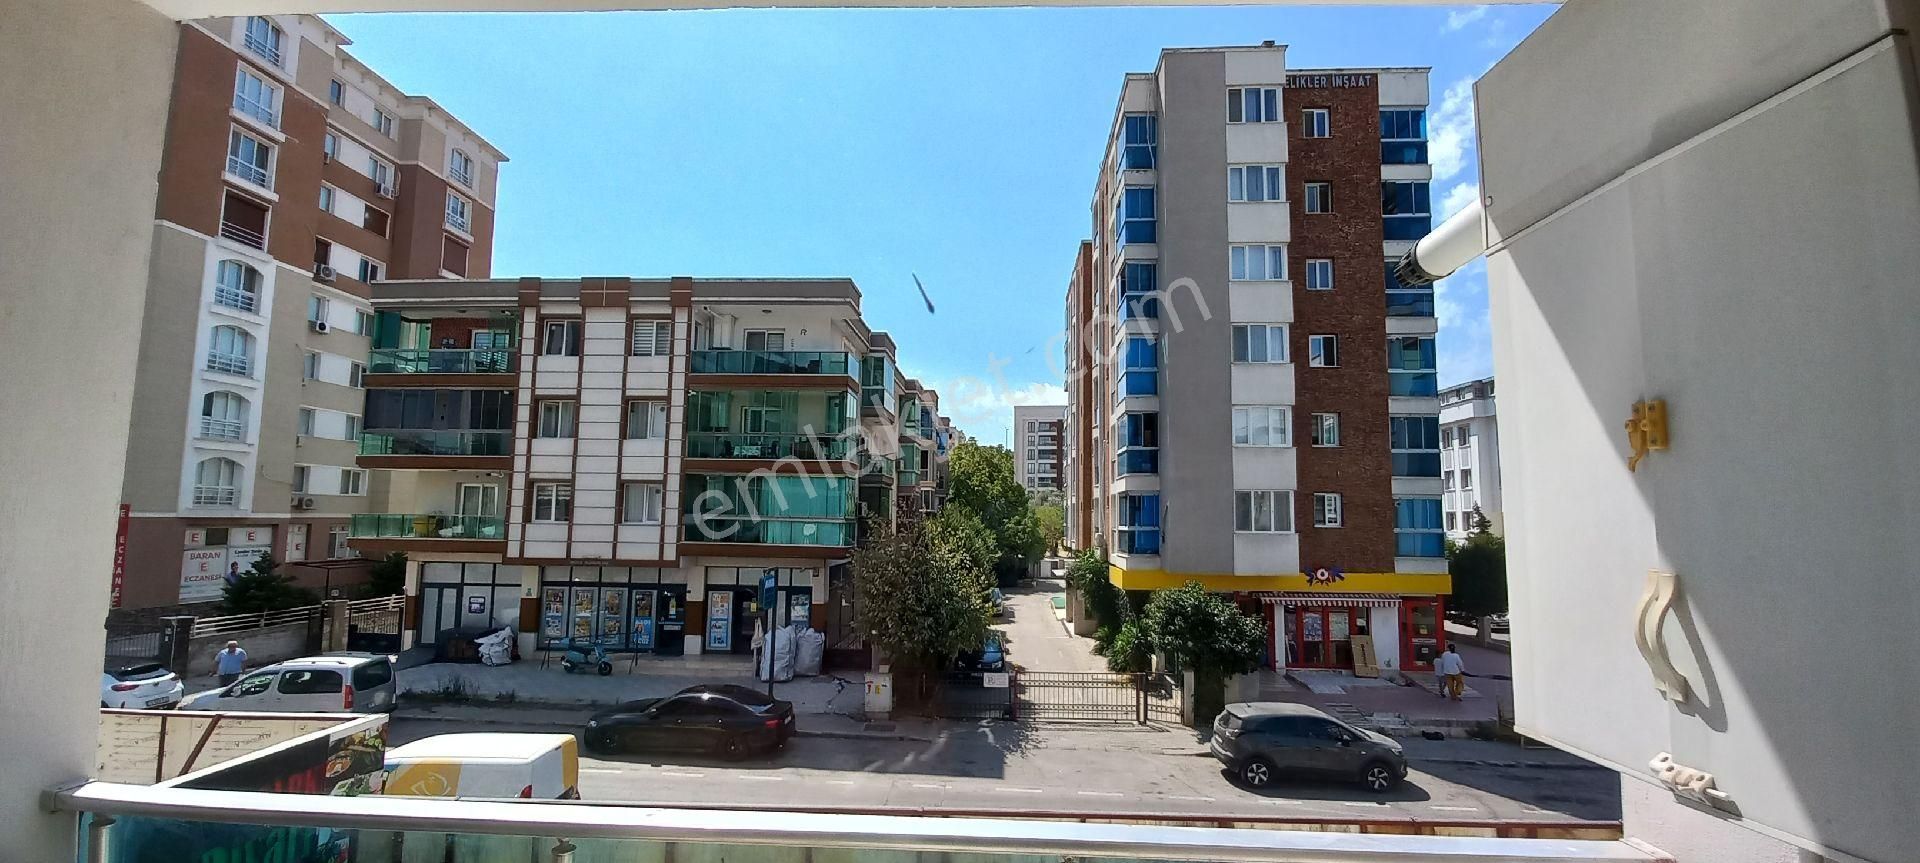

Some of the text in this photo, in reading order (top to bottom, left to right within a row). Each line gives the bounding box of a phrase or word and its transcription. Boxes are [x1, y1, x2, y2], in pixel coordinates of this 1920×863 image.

[1332, 71, 1371, 88] İNŞAAT
[192, 533, 199, 542] E
[247, 532, 255, 541] E
[190, 552, 221, 560] BARAN
